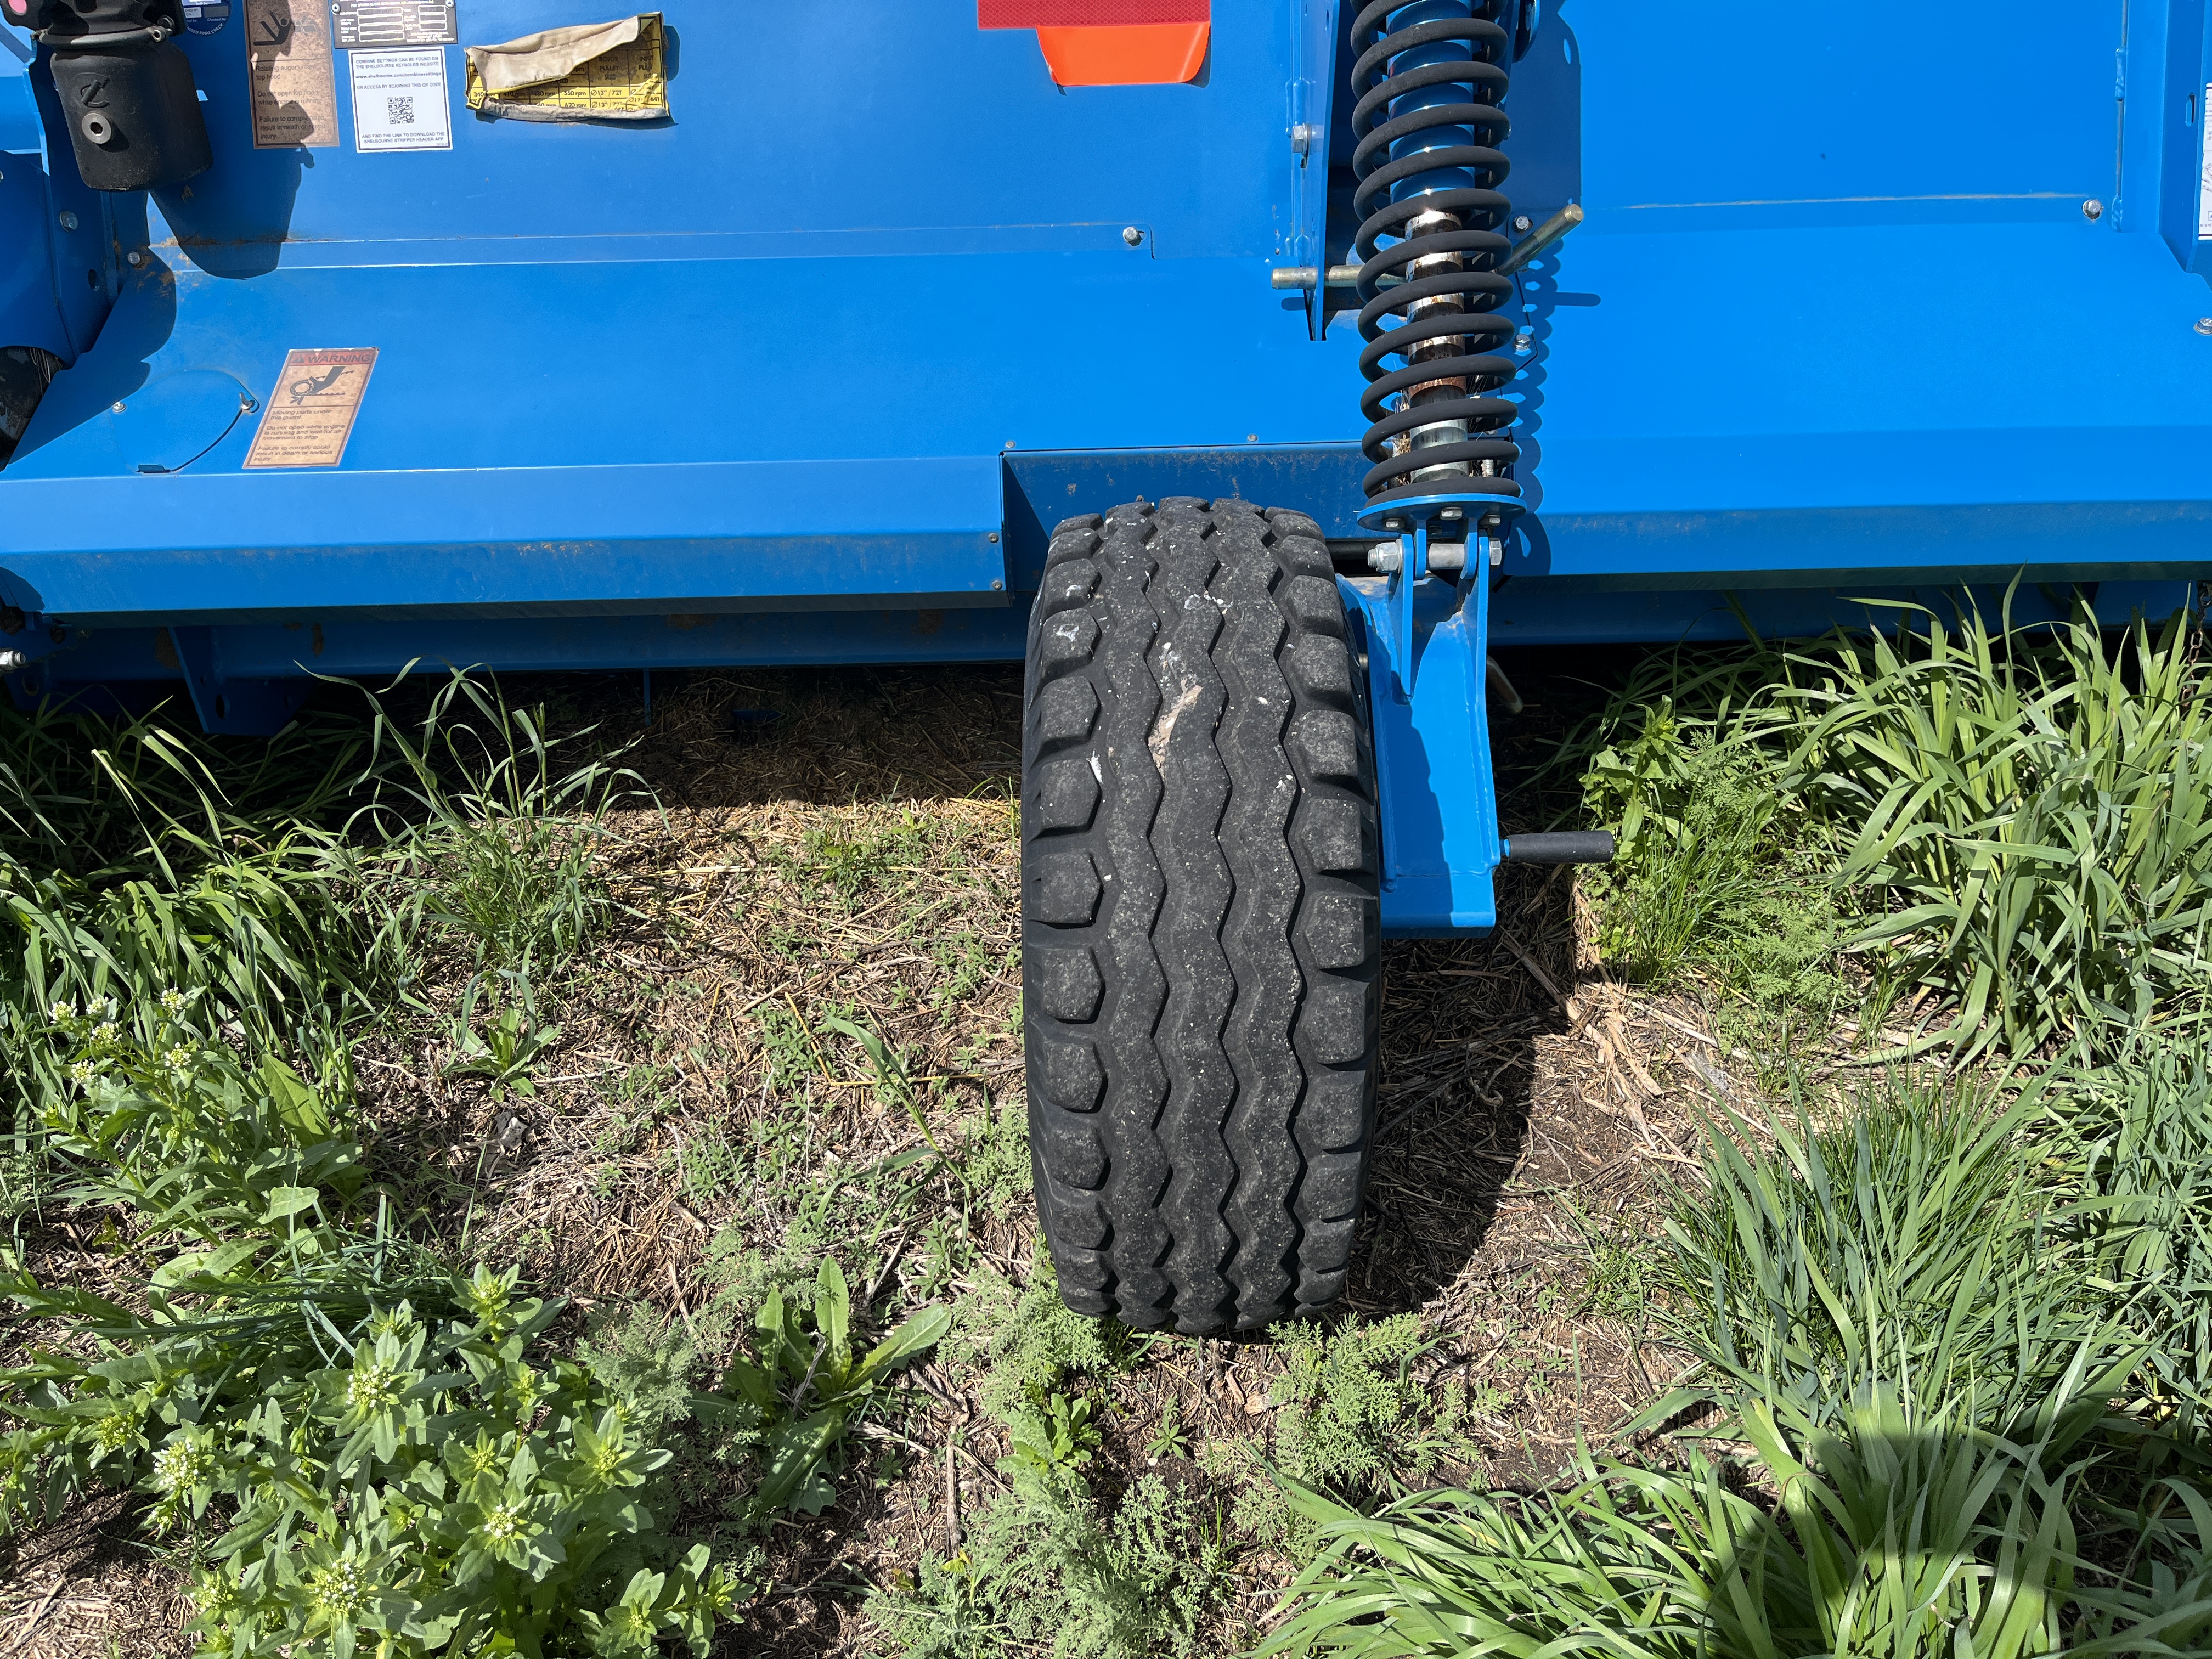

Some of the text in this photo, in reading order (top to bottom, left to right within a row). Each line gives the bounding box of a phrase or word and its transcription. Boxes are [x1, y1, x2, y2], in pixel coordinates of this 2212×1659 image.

[211, 23, 224, 33] CHECK
[287, 115, 307, 123] comply
[308, 354, 371, 363] WARNING
